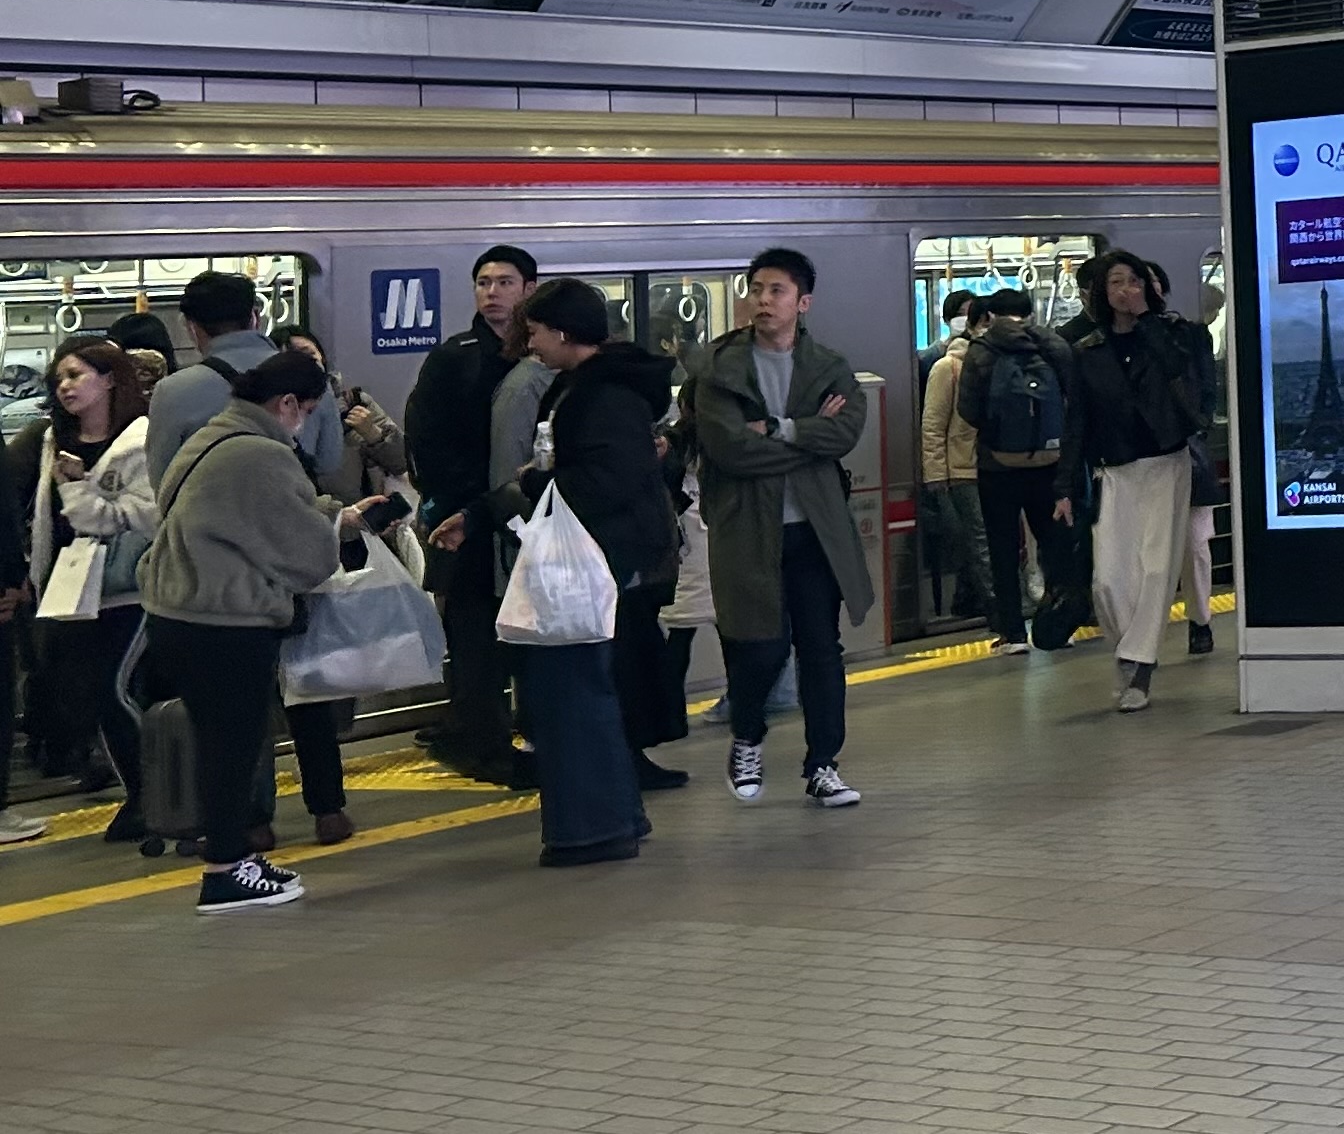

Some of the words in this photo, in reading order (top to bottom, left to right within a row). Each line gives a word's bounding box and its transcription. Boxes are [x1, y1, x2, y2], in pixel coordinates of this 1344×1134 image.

[377, 337, 407, 347] Osaka
[408, 336, 437, 345] Metro
[1303, 482, 1337, 493] KANSAI
